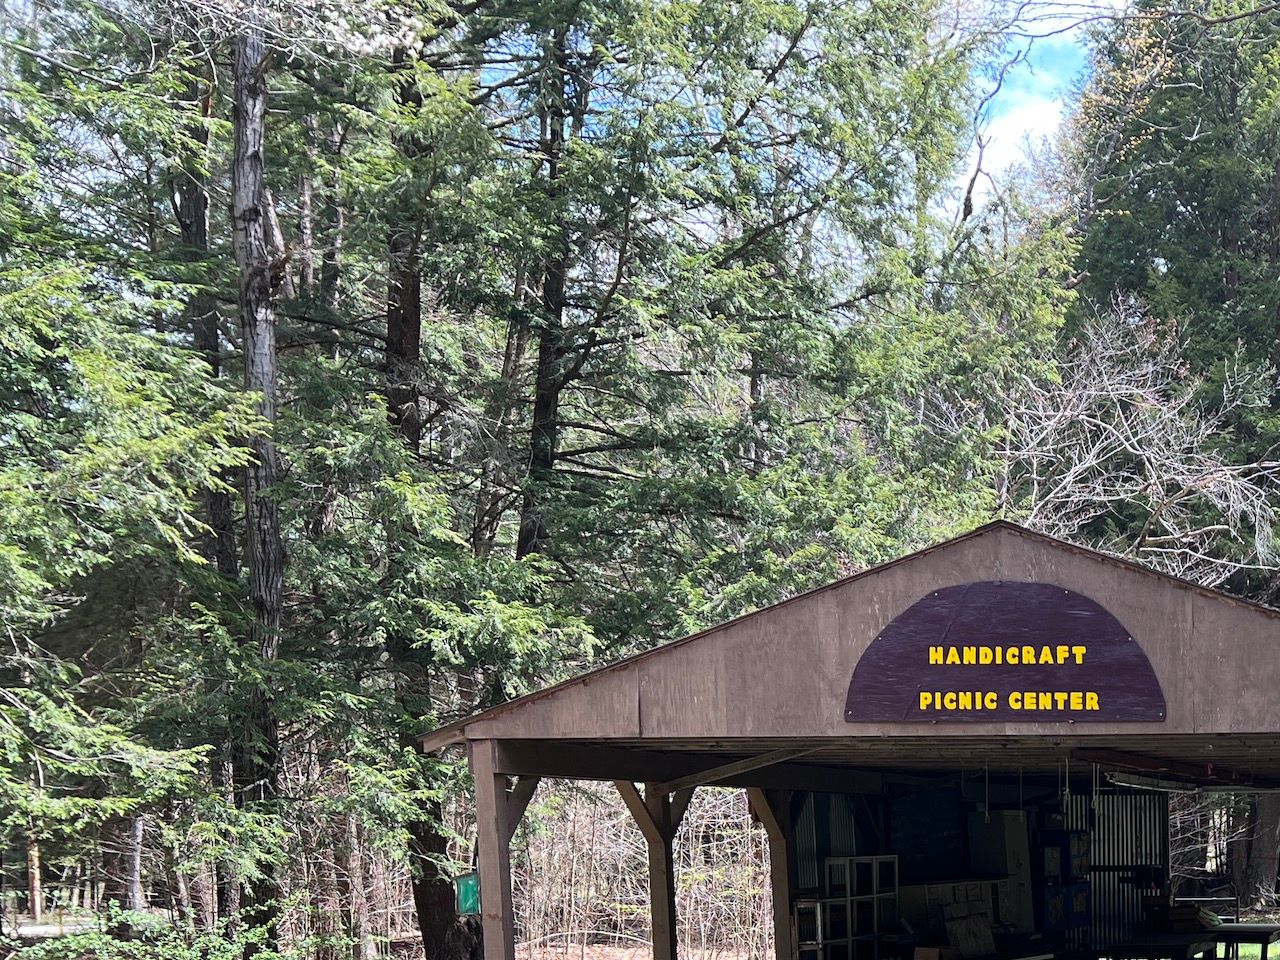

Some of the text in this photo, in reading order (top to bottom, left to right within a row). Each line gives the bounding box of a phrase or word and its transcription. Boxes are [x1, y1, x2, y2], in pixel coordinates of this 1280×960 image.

[929, 646, 1086, 665] HANDICRAFT
[919, 692, 1100, 710] PICNIC CENTER
